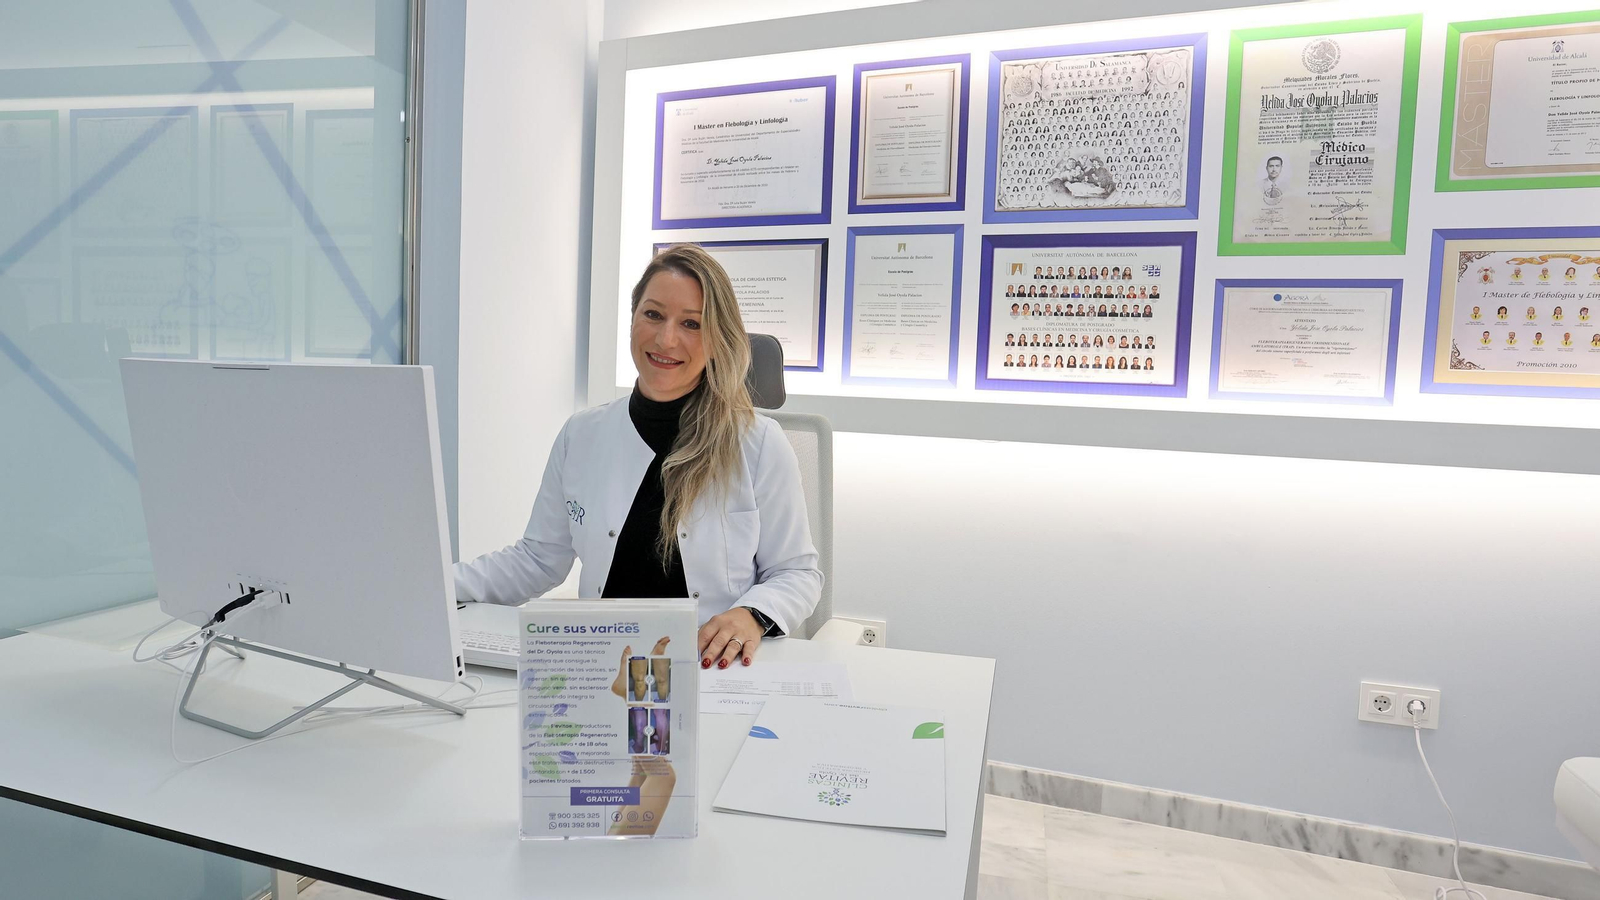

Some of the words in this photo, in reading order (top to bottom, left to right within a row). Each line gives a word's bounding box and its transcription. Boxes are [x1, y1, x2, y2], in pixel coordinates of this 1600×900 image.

[1321, 141, 1365, 154] Médico
[1316, 154, 1369, 167] Cirujano
[527, 623, 560, 633] Cure
[564, 625, 586, 633] sus
[590, 623, 640, 633] varices
[808, 772, 868, 784] REVITAE
